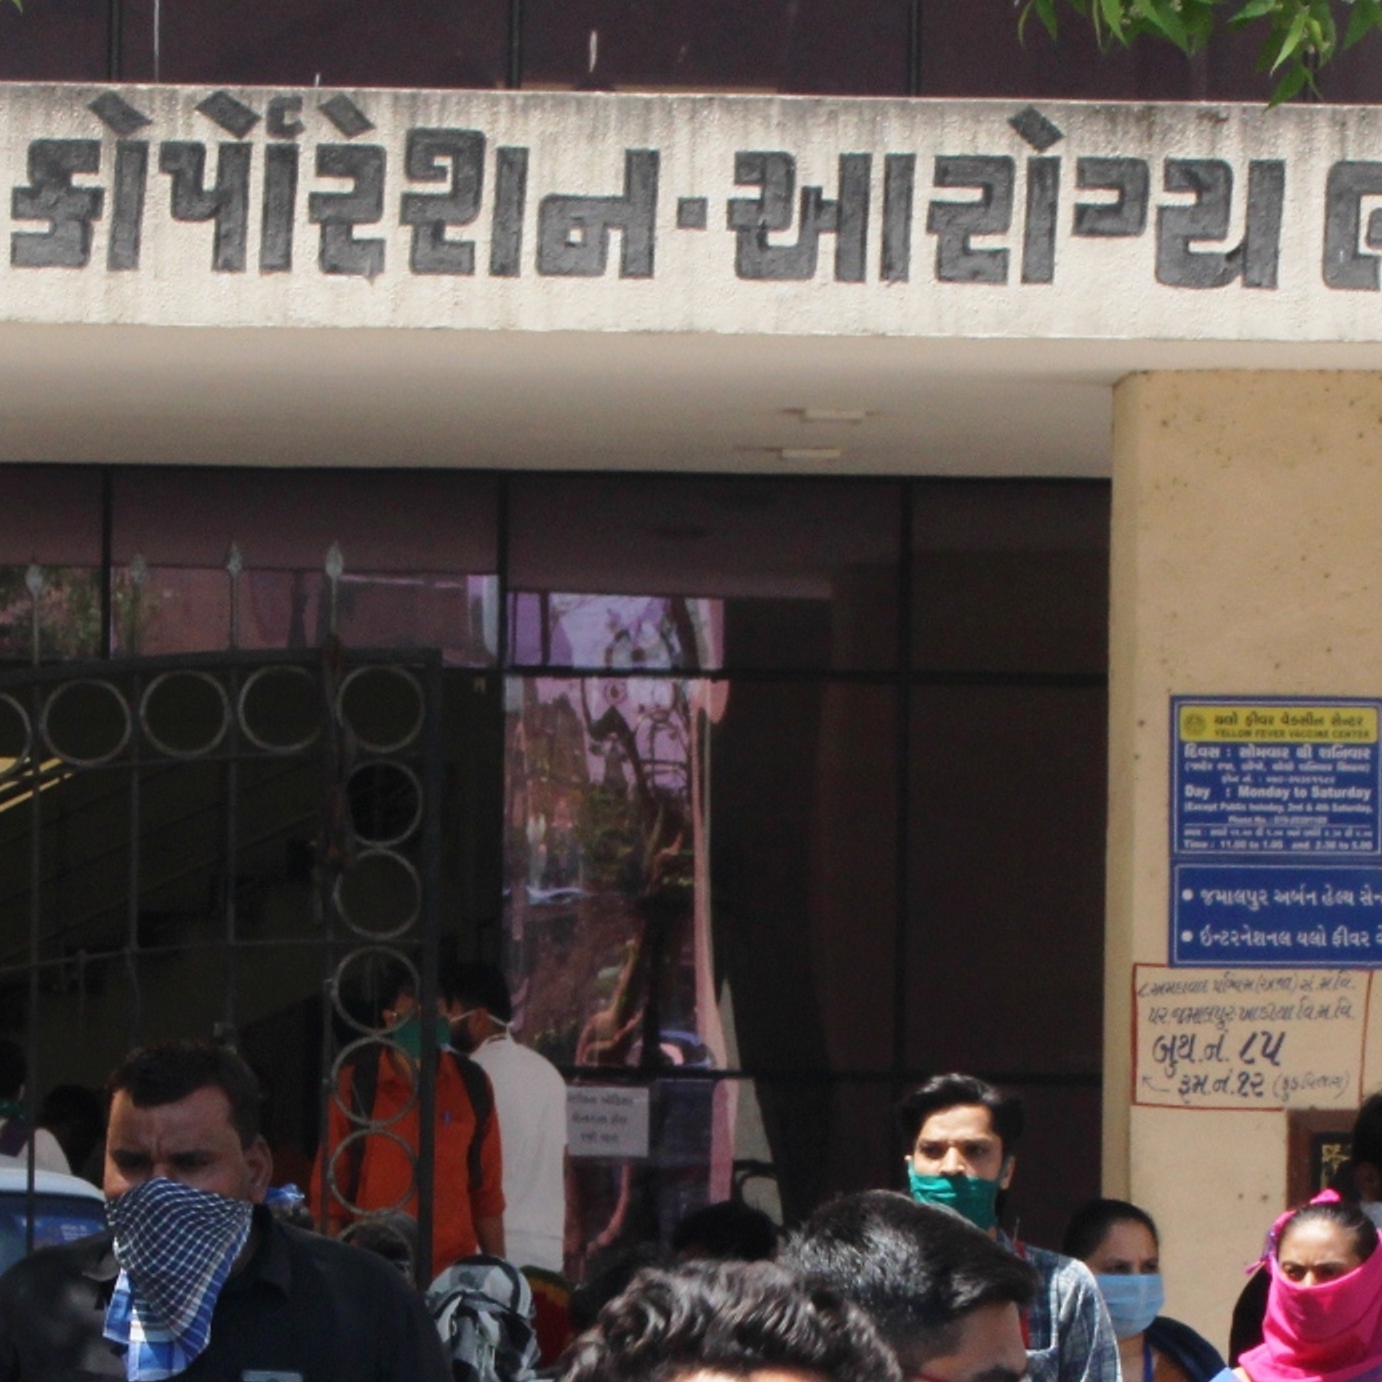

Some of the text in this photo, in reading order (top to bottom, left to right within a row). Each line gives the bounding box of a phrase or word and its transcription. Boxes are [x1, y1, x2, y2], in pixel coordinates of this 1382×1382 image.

[1214, 728, 1253, 738] YELLOW
[1255, 728, 1286, 738] FEVER
[1183, 743, 1222, 759] દિવસ
[1184, 784, 1212, 801] Day
[1237, 784, 1291, 801] Monday
[1294, 785, 1308, 798] to
[1311, 784, 1372, 801] Saturday
[1199, 889, 1269, 911] જમાલપુર
[1273, 885, 1317, 906] અર્બન
[1297, 923, 1327, 946] યલો
[1331, 924, 1371, 947] ફીવર
